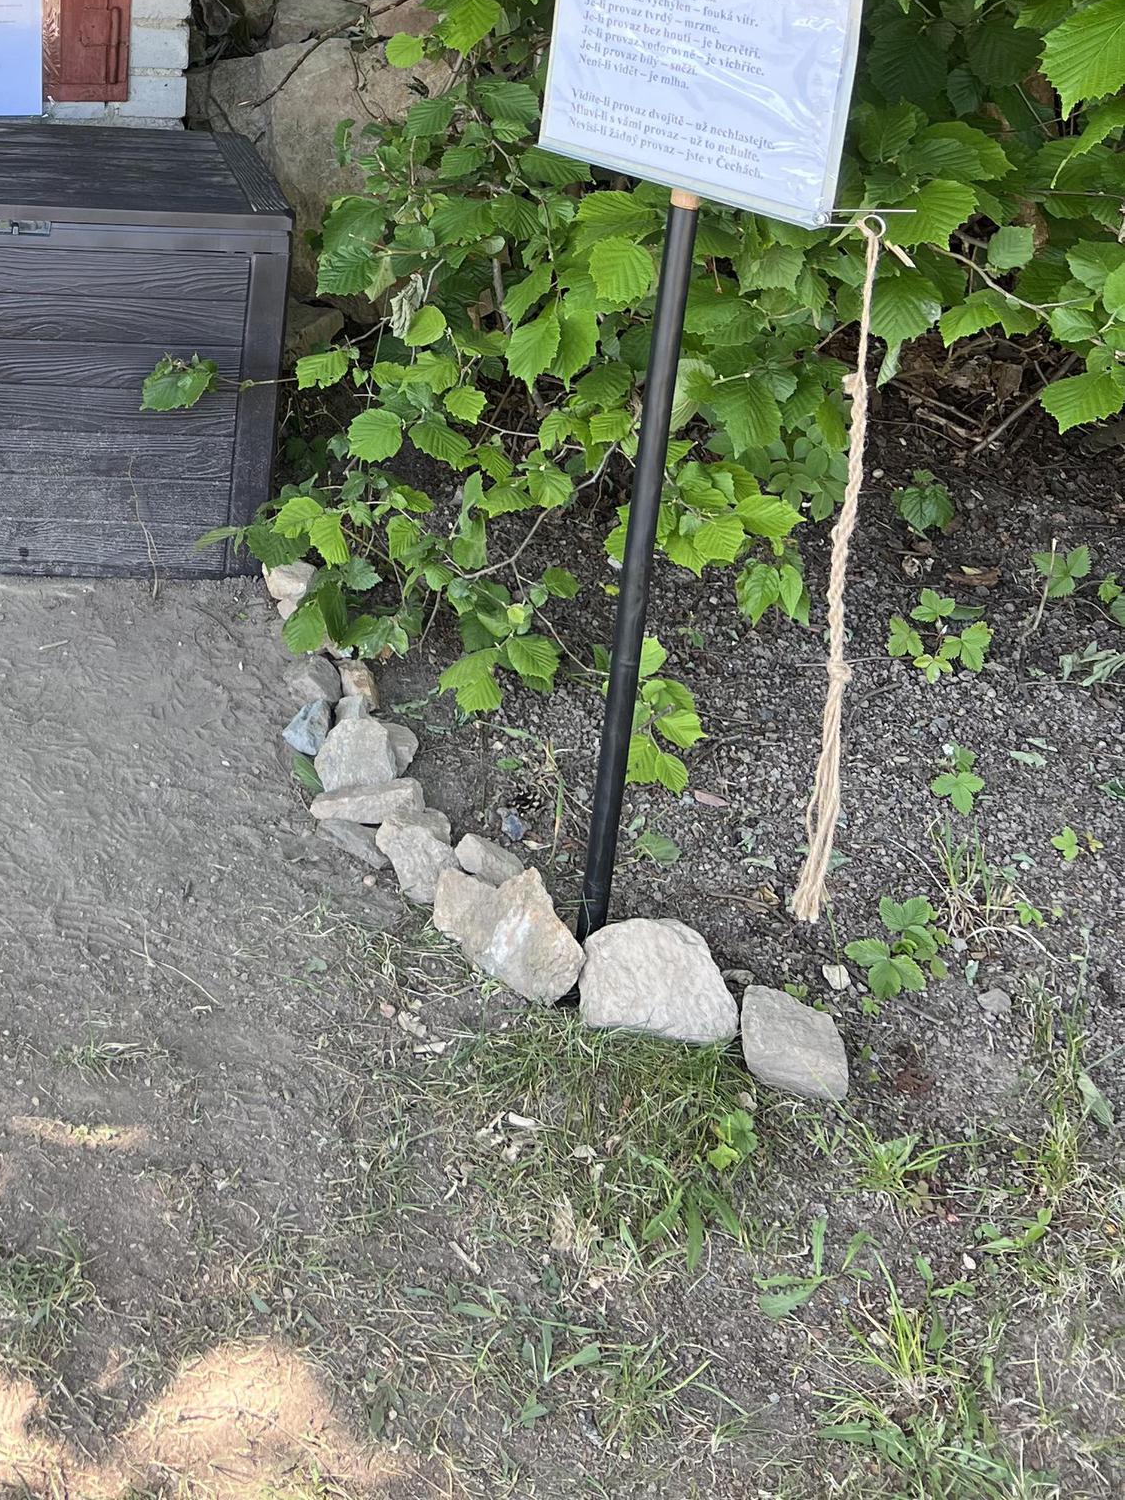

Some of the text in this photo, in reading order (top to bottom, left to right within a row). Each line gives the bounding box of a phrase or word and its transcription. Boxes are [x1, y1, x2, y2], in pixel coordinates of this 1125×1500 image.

[608, 3, 643, 17] provaz
[645, 9, 673, 26] tvrdý
[684, 19, 720, 34] mrzne.
[703, 5, 734, 21] fouká
[583, 10, 605, 24] Je-li
[606, 18, 641, 32] provaz
[643, 23, 661, 36] bez
[715, 39, 761, 59] bezvětří.
[580, 39, 602, 53] Je-li
[603, 47, 638, 62] provaz
[581, 24, 603, 38] Je-li
[604, 32, 640, 47] provaz
[719, 57, 765, 76] vichřice.
[661, 75, 689, 89] mlha.
[612, 101, 647, 117] provaz
[617, 116, 642, 131] vámi
[644, 124, 679, 140] provaz
[609, 127, 637, 147] žádný
[640, 138, 675, 155] provaz
[685, 147, 705, 163] jste
[716, 155, 764, 178] Čechách.
